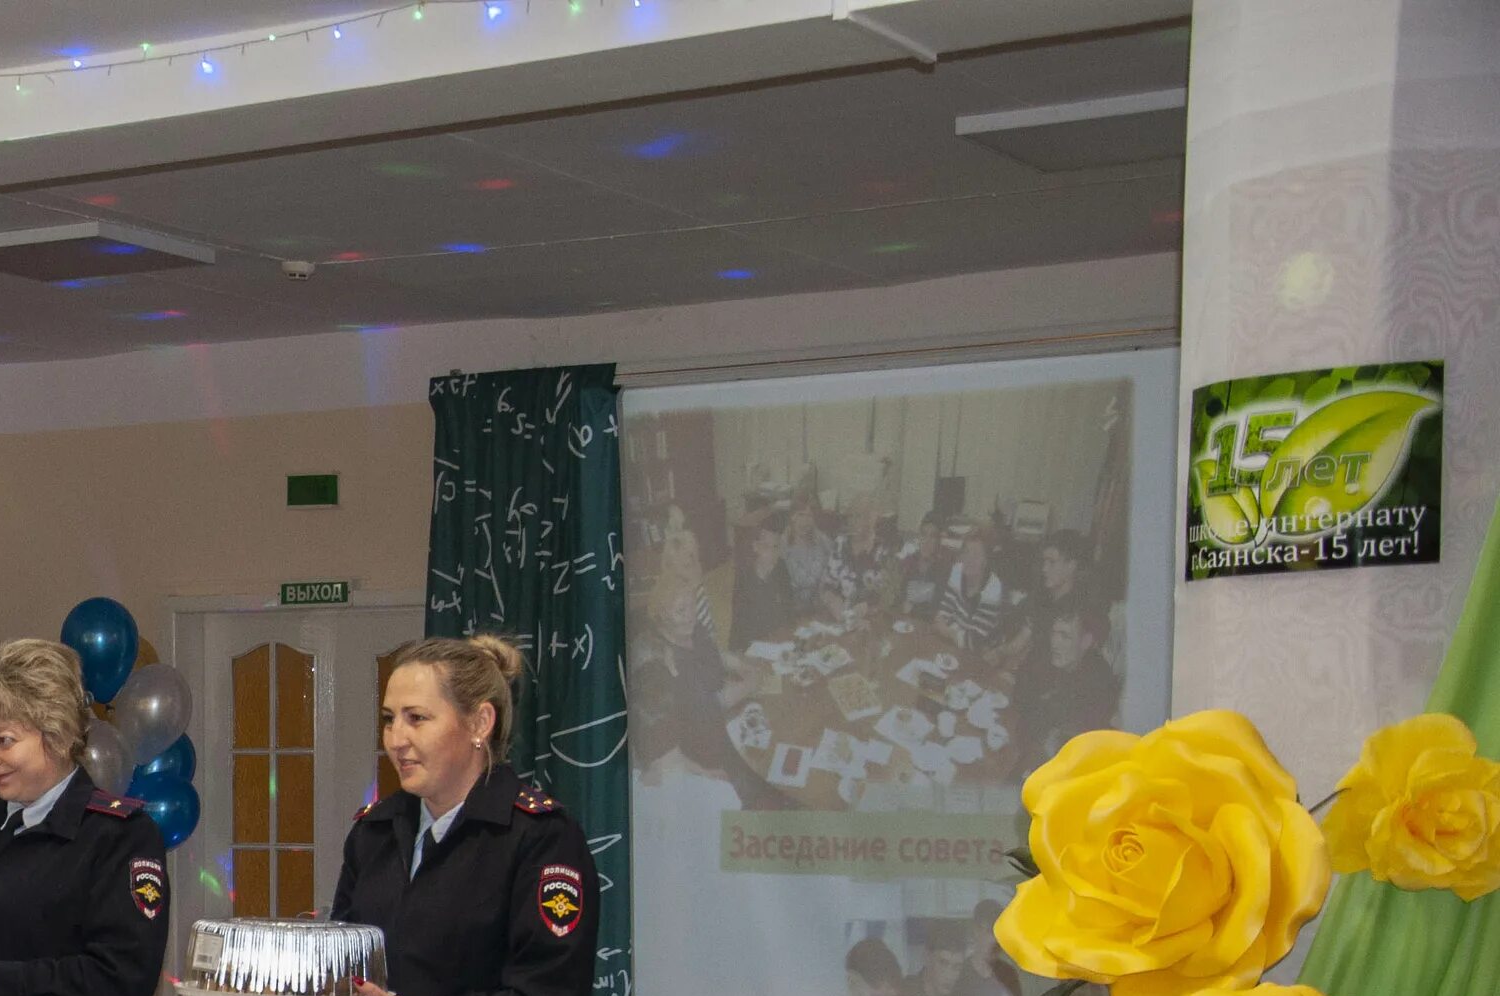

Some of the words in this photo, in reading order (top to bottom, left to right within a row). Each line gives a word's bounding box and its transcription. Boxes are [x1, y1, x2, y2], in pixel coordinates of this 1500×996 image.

[1207, 408, 1298, 497] 15
[1266, 453, 1372, 490] лет
[1189, 505, 1426, 543] шке-интернату
[1360, 532, 1420, 558] лет!
[285, 584, 343, 602] ВЫХОД
[729, 826, 887, 868] Заседание
[898, 835, 1004, 865] совета
[136, 873, 162, 887] РОССИЯ
[543, 866, 580, 881] ПОЛИЦИЯ
[543, 882, 578, 897] РОССИЯ
